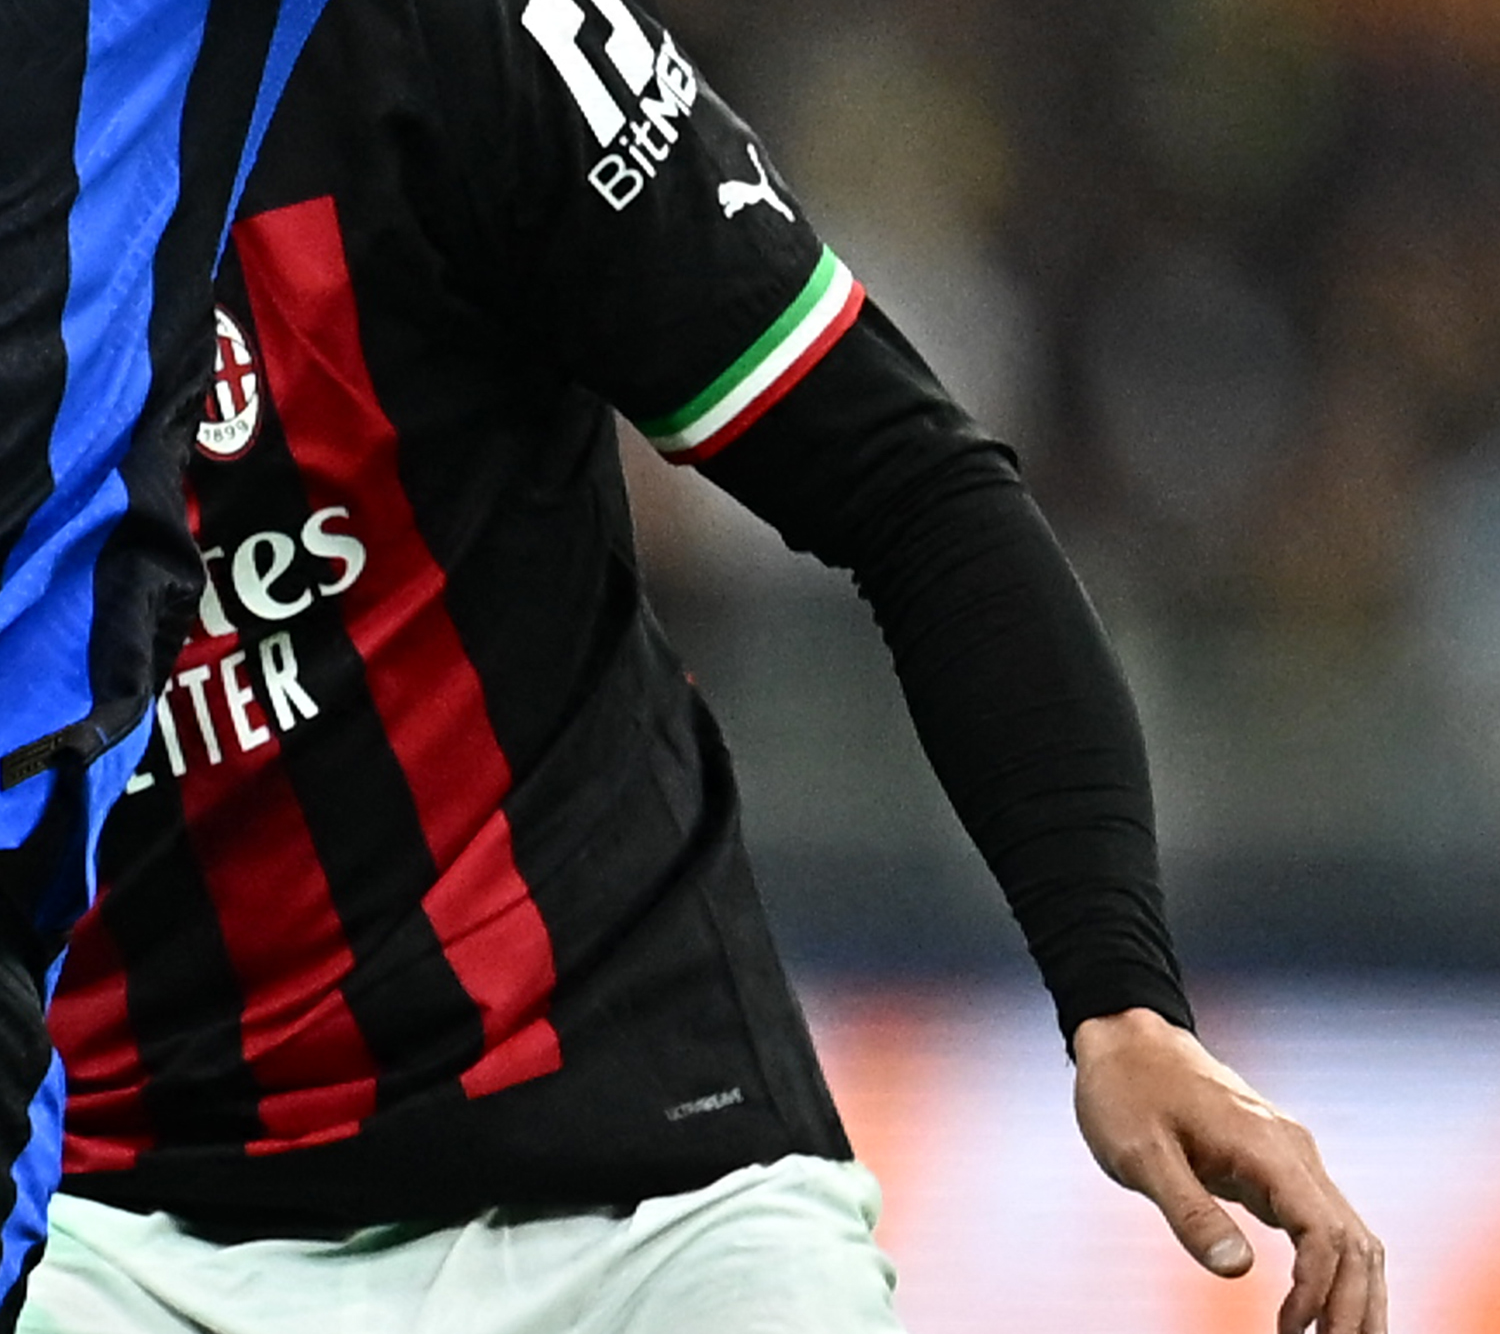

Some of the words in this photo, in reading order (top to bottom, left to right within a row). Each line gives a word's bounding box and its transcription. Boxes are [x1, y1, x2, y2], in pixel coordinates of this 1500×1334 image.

[203, 419, 251, 444] 1899
[188, 505, 367, 642] res
[126, 630, 320, 796] TTER
